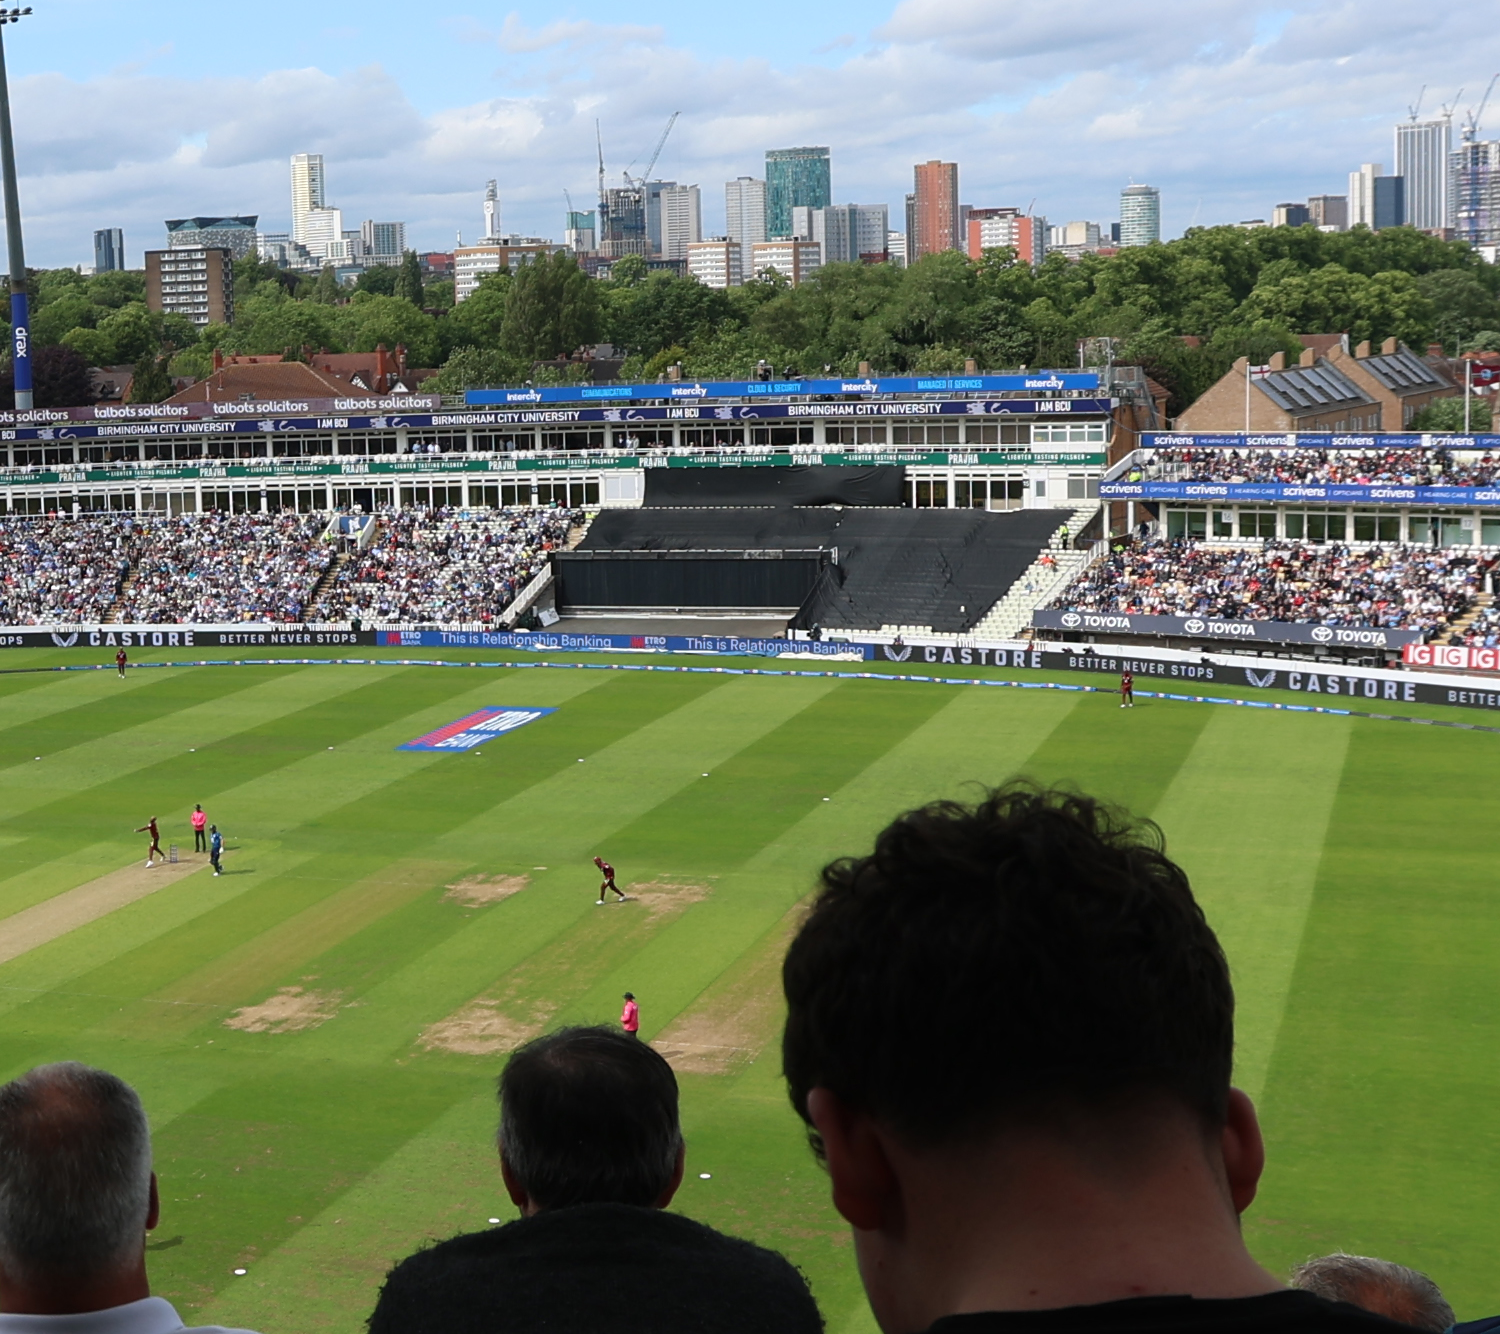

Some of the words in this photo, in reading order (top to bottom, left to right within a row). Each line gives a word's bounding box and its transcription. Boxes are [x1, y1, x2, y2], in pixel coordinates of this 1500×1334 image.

[15, 327, 28, 358] drax
[774, 383, 801, 392] SECURITY
[918, 380, 946, 389] MANAGED
[955, 379, 982, 388] SERVICES
[213, 402, 254, 414] talbots
[256, 400, 308, 412] solicitors
[334, 398, 376, 410] talbots
[378, 396, 432, 408] solicitors
[788, 406, 854, 416] BIRMINGHAM
[856, 404, 878, 414] CITY
[880, 403, 942, 414] UNIVERSITY
[17, 410, 68, 422] solicitors
[432, 414, 495, 426] BIRMINGHAM
[497, 413, 519, 424] CITY
[521, 411, 580, 422] UNIVERSITY
[97, 424, 157, 436] BIRMINGHAM
[159, 423, 181, 433] CITY
[182, 422, 236, 433] UNIVERSITY
[1283, 486, 1326, 497] scrivens
[1370, 487, 1415, 498] scrivens
[1084, 615, 1131, 629] TOYOTA
[1207, 622, 1255, 636] TOYOTA
[90, 631, 195, 647] CASTORE
[220, 634, 265, 644] BETTER
[271, 633, 311, 644] NEVER
[316, 633, 357, 643] STOPS
[440, 632, 466, 644] This
[469, 633, 479, 644] is
[482, 633, 558, 647] Relationship
[561, 634, 612, 648] Banking
[1336, 629, 1387, 645] TOYOTA
[924, 646, 1042, 668] CASTORE
[1289, 672, 1416, 702] CASTORE
